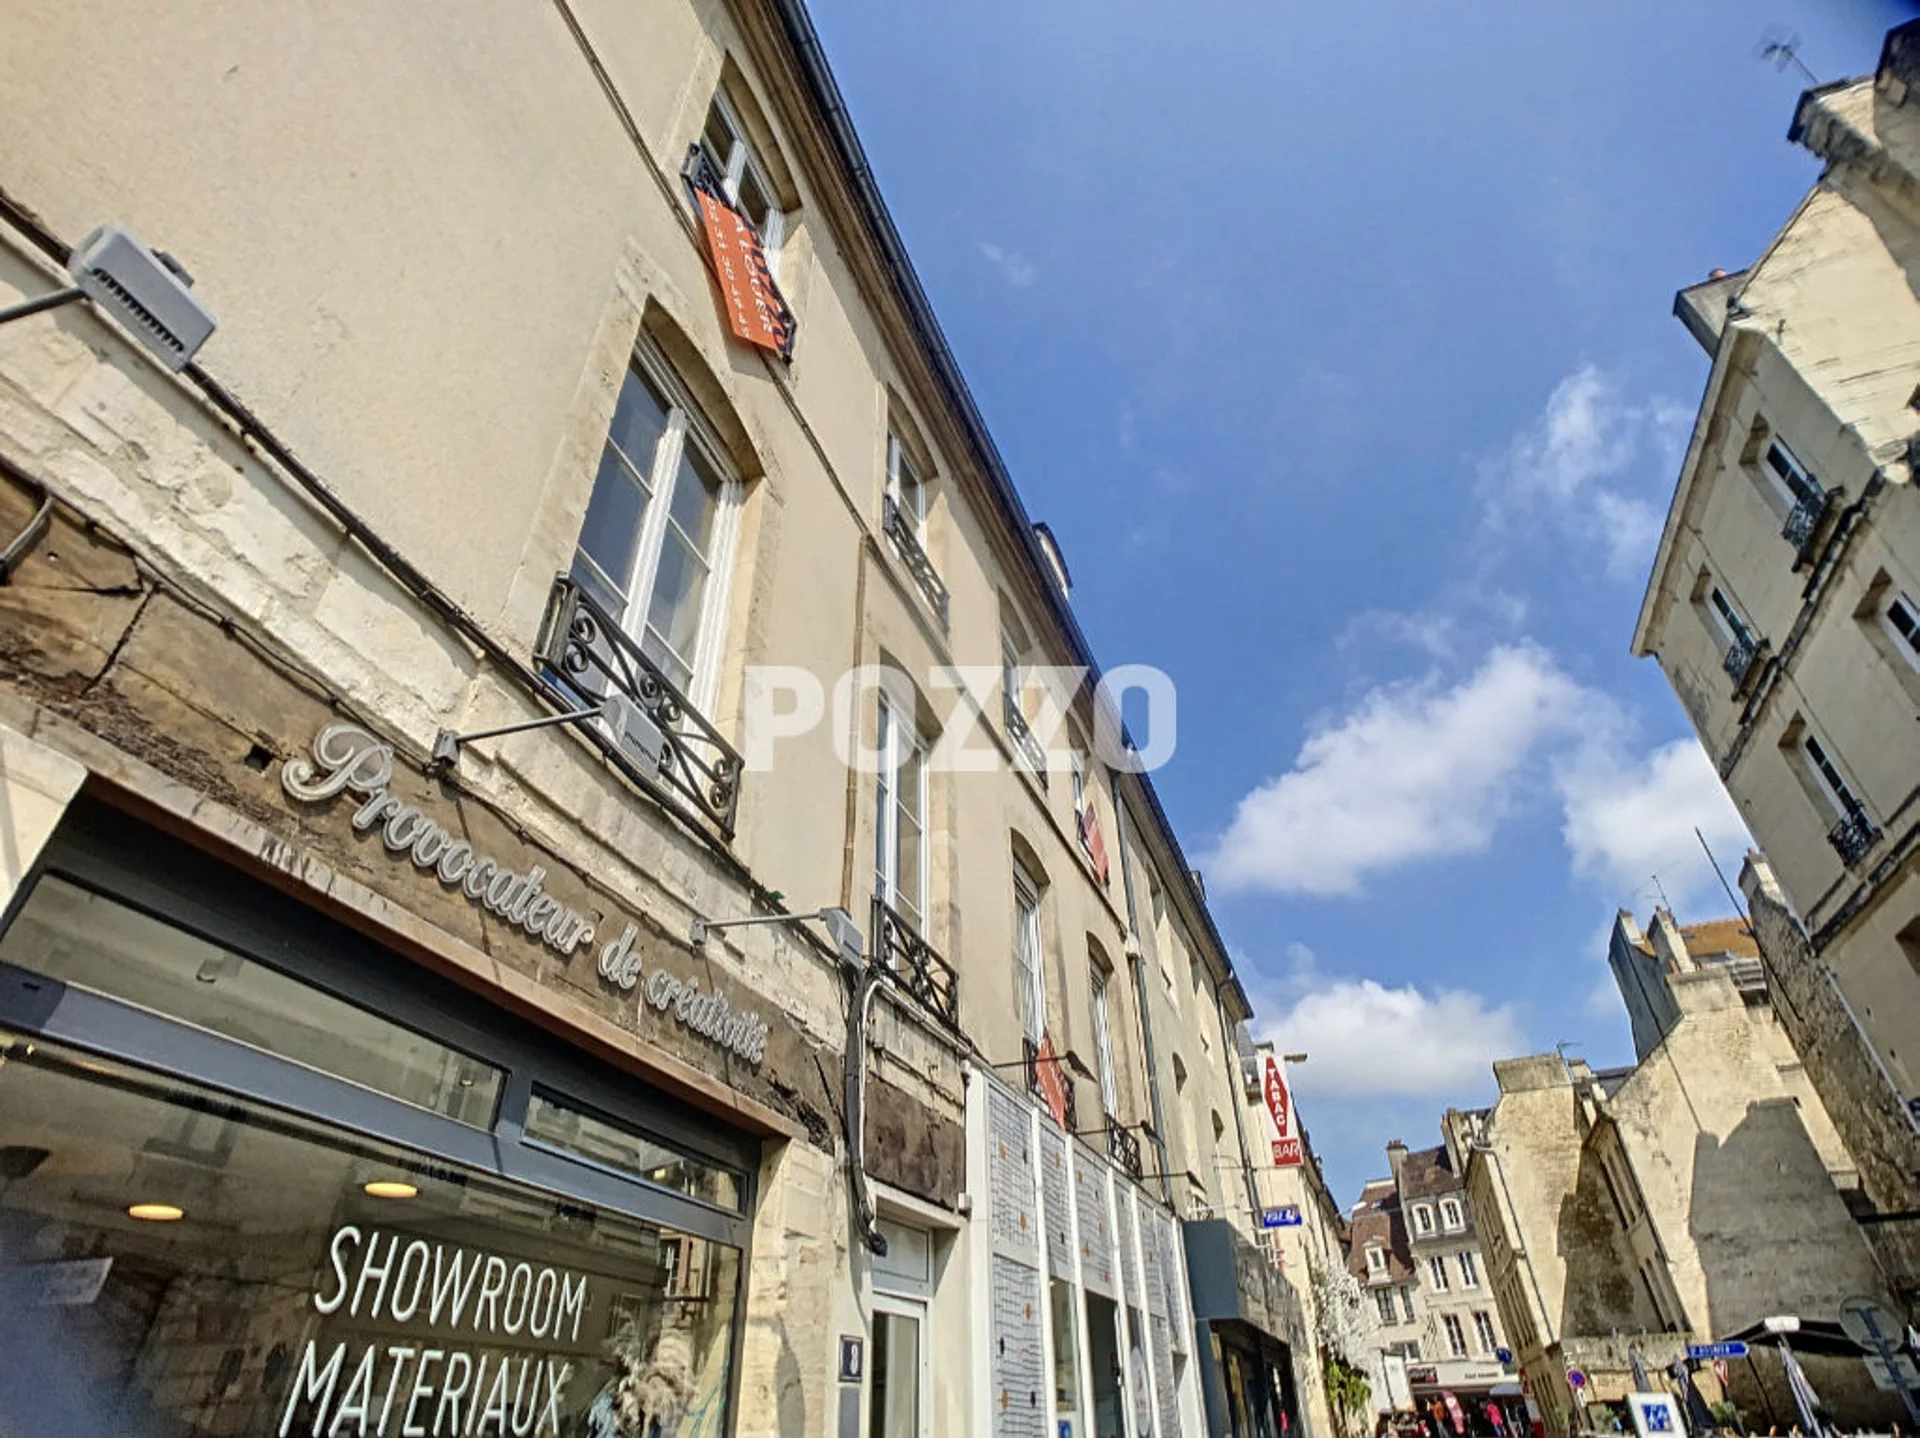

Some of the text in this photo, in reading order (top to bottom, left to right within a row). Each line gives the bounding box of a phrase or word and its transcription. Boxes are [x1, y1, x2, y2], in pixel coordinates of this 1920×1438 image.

[739, 239, 773, 333] LOUER
[281, 723, 597, 955] Provocateur
[598, 921, 644, 990] de
[1267, 1068, 1287, 1126] TABAC
[1273, 1141, 1300, 1159] BAR
[314, 1226, 588, 1343] SHOWROOM
[278, 1339, 571, 1438] MATERIAUX
[849, 1343, 859, 1375] 8
